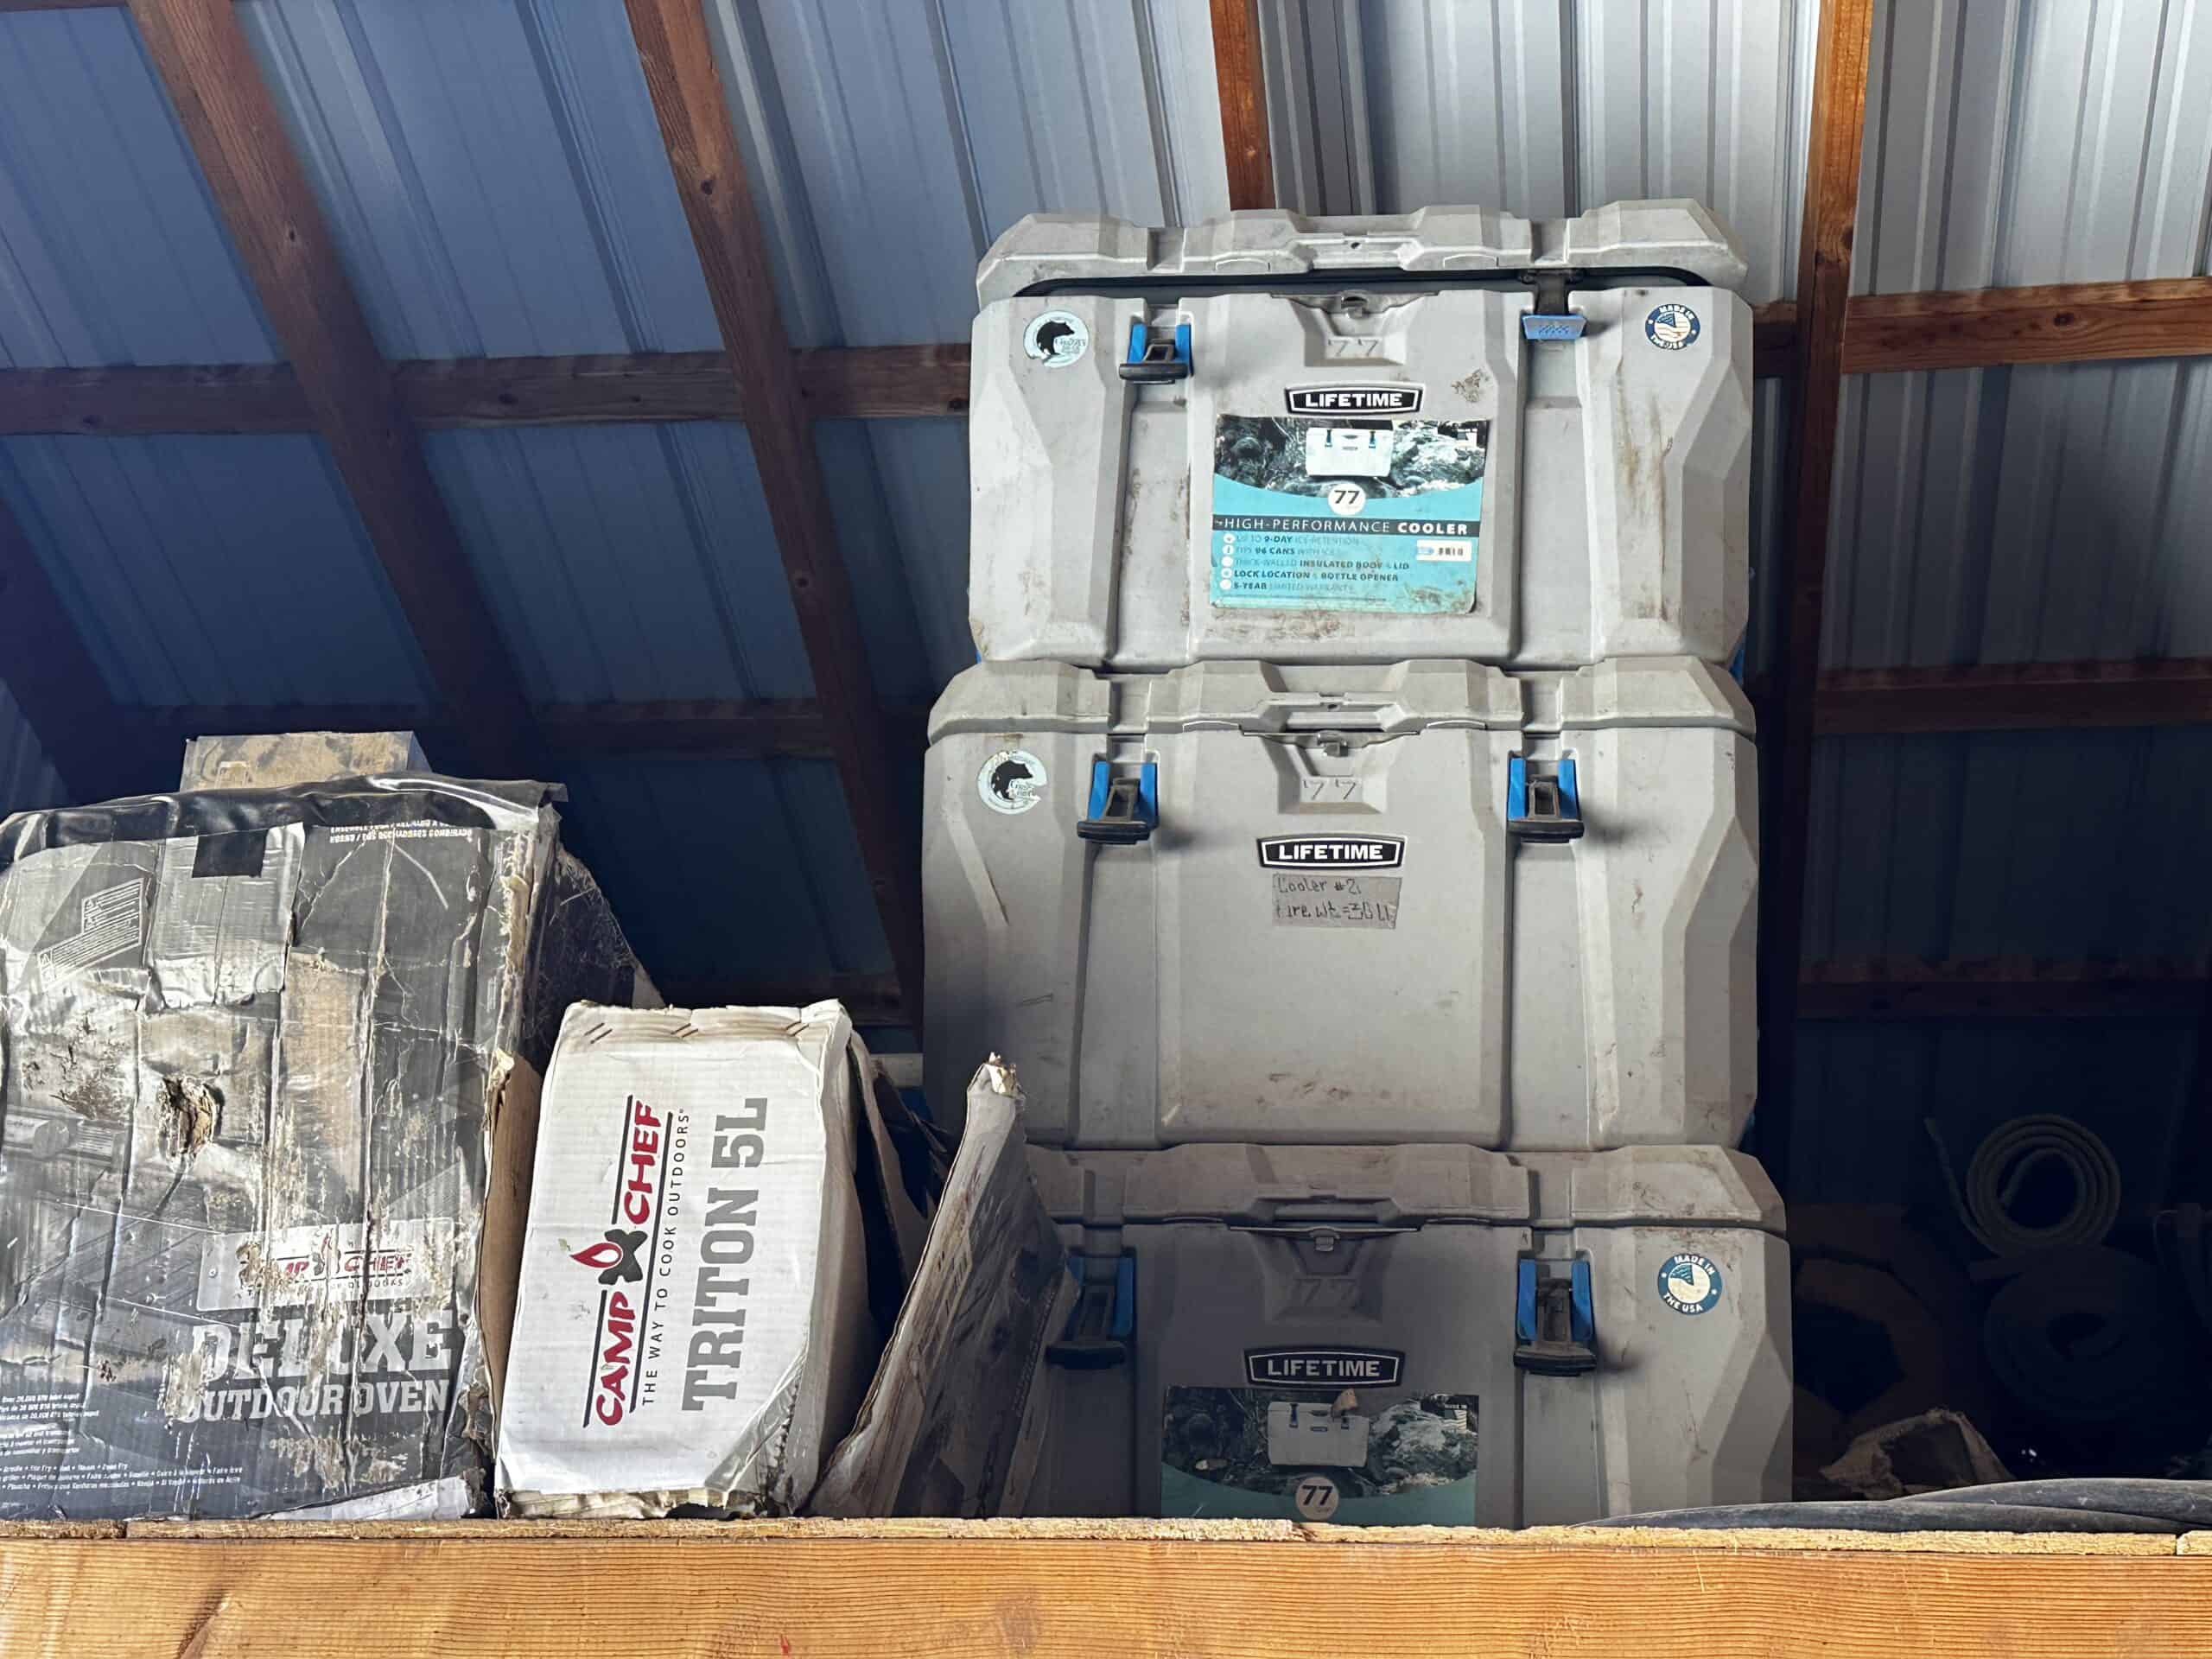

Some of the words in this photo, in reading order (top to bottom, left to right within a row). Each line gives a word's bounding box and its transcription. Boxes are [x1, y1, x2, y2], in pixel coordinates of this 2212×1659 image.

[1306, 393, 1403, 407] LIFETIME
[1334, 490, 1360, 505] 77
[1224, 518, 1390, 533] HIGH-PERFORMANCE
[1397, 522, 1468, 535] COOLER
[1264, 535, 1294, 543] 9-DAY
[1300, 560, 1353, 569] INSULATED
[1360, 573, 1399, 582] OPENER
[1303, 779, 1357, 800] 77
[1279, 844, 1383, 860] LIFETIME
[1278, 876, 1327, 893] Cooler
[710, 1097, 768, 1169] 5L
[667, 1113, 690, 1217] OUTDOORS
[659, 1226, 677, 1277] COOK
[596, 1291, 636, 1427] CAMP
[624, 1100, 662, 1224] CHEF
[1674, 1255, 1705, 1266] MADE
[1704, 1262, 1715, 1275] IN
[654, 1287, 669, 1312] TO
[681, 1187, 760, 1411] TRITON
[1662, 1292, 1681, 1309] THE
[1681, 1303, 1704, 1313] USA
[648, 1320, 664, 1360] WAY
[1267, 1359, 1380, 1376] LIFETIME
[353, 1380, 449, 1418] OVEN
[642, 1370, 658, 1407] THE
[1302, 1484, 1333, 1505] 77
